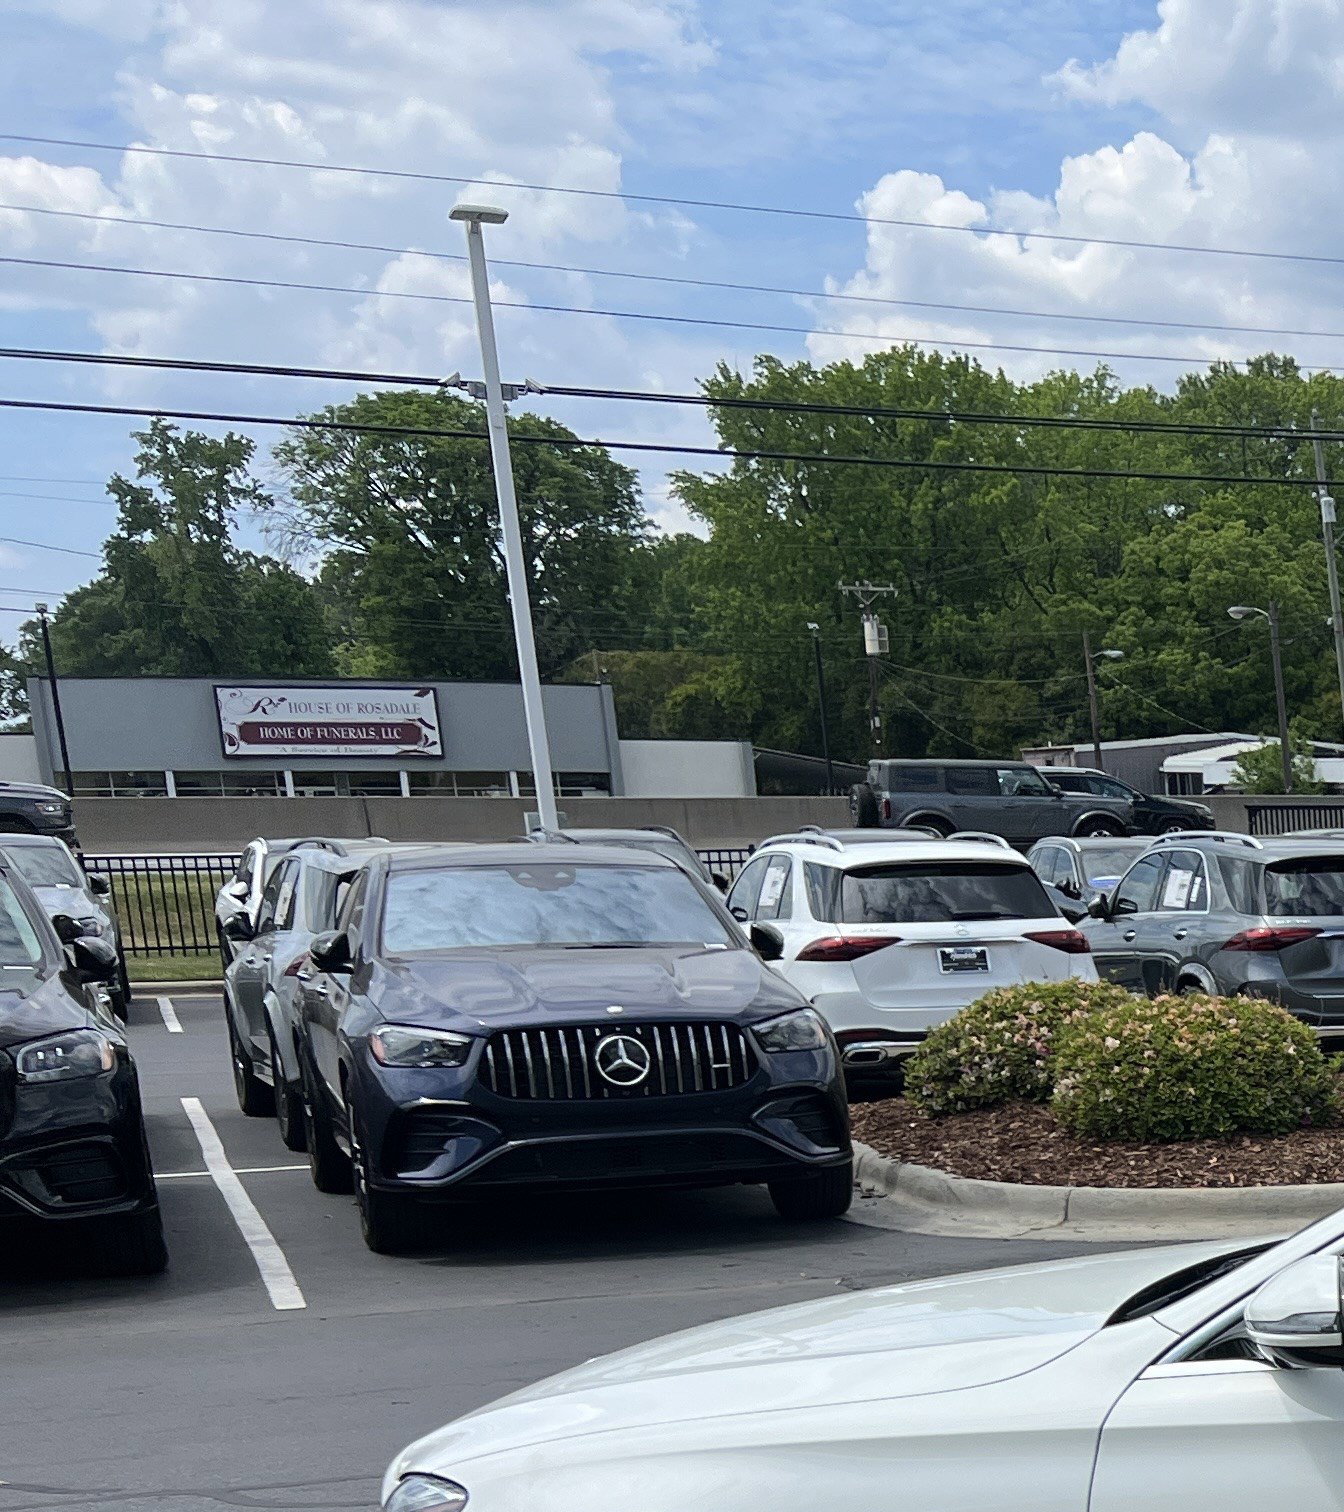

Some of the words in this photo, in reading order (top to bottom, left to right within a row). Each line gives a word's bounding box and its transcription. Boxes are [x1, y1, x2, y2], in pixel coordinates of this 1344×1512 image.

[288, 702, 332, 715] HOUSE
[336, 702, 352, 715] OF
[357, 702, 421, 715] ROSADALE
[259, 726, 296, 739] HOME
[298, 726, 314, 739] OF
[317, 726, 380, 740] FUNERALS,
[381, 727, 402, 739] LLC
